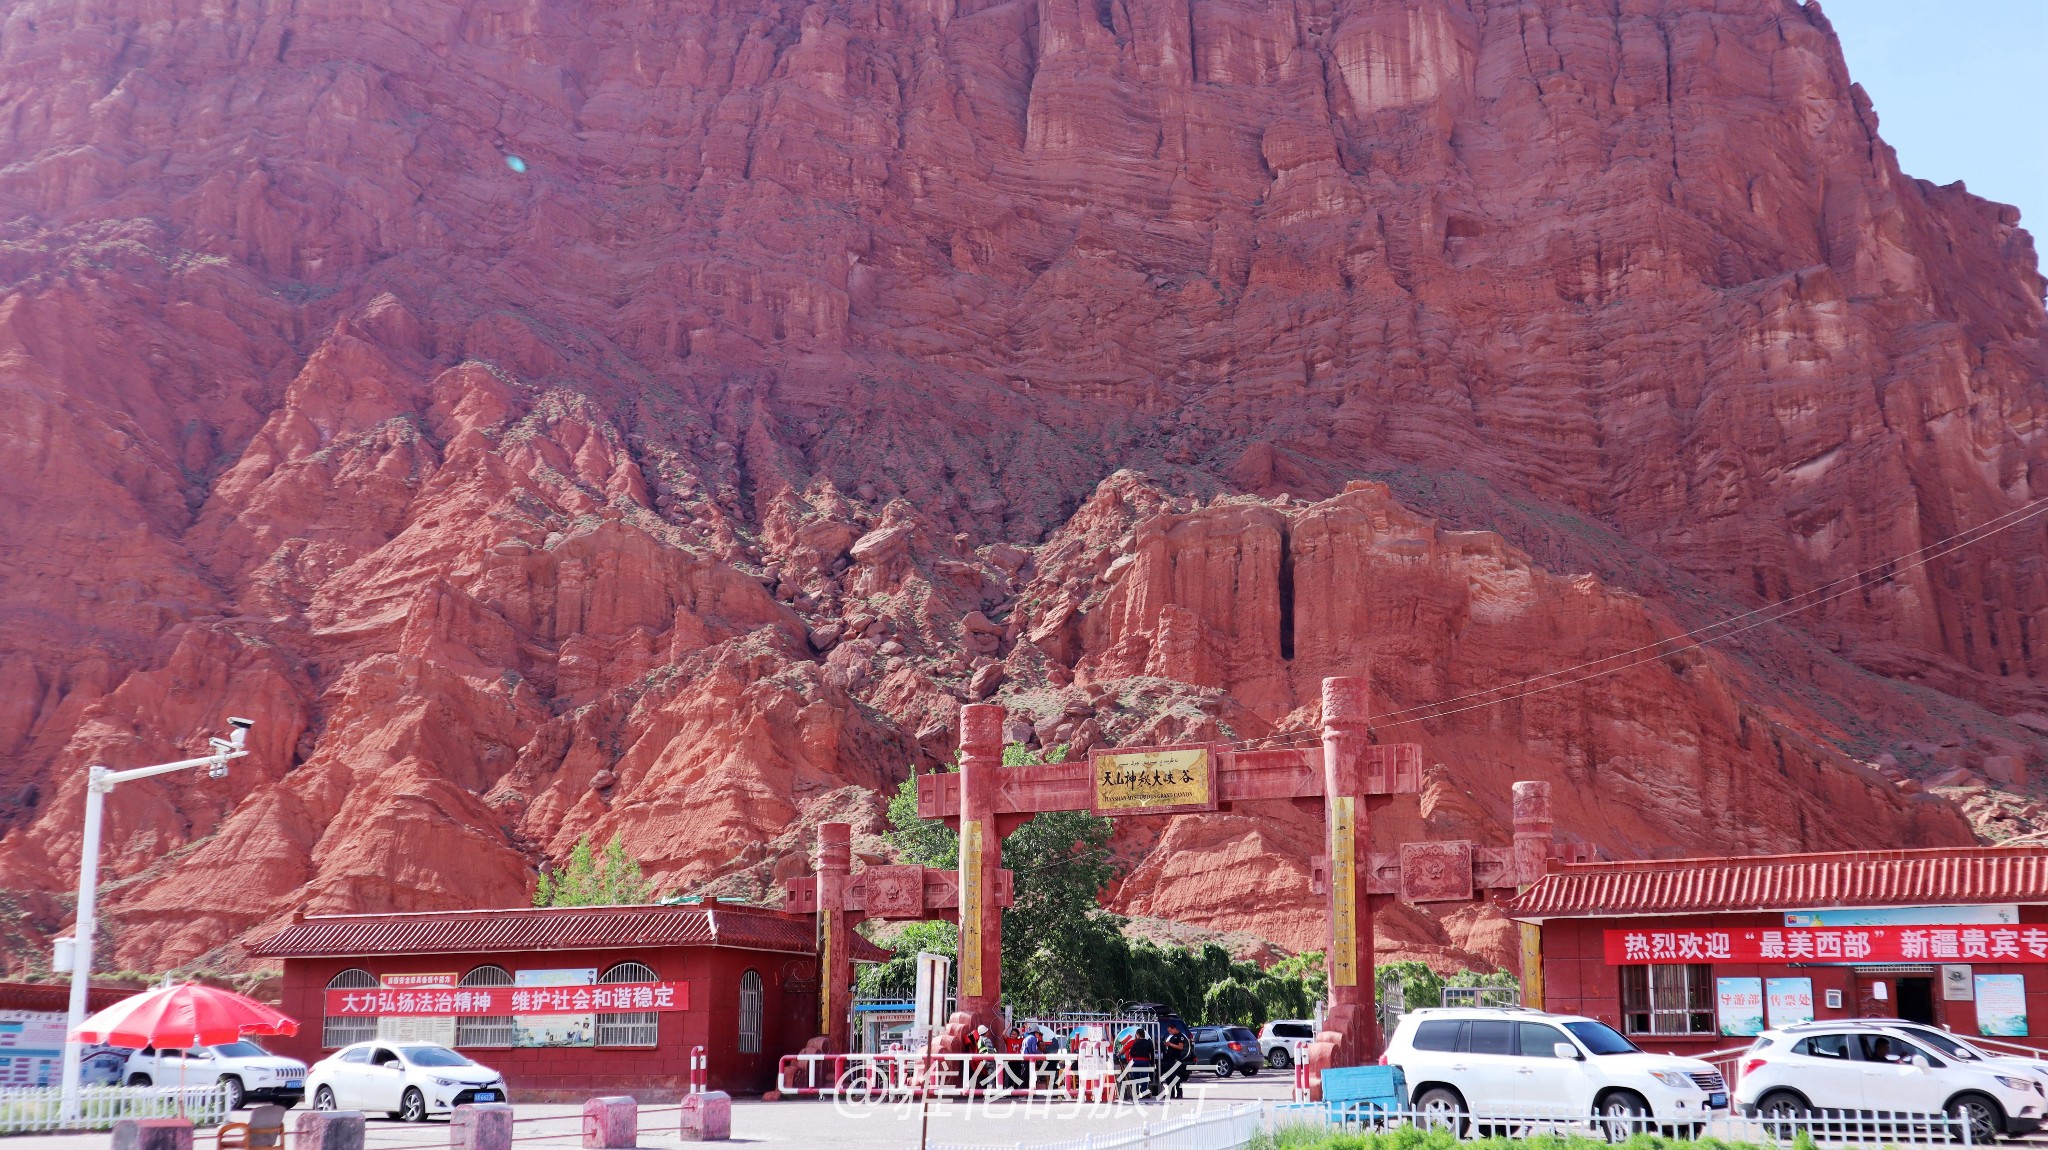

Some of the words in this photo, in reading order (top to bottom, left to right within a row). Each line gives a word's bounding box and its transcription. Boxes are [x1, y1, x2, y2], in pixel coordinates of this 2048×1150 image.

[1624, 931, 1732, 961] 热烈欢迎
[1745, 929, 1886, 961] “最美西部”
[1901, 927, 2048, 960] 新疆贵宾专
[341, 990, 491, 1014] 大力弘扬法治精神
[511, 985, 675, 1012] 维护社会和谐稳定
[1720, 993, 1760, 1006] 导游部
[1770, 993, 1811, 1006] 售票处
